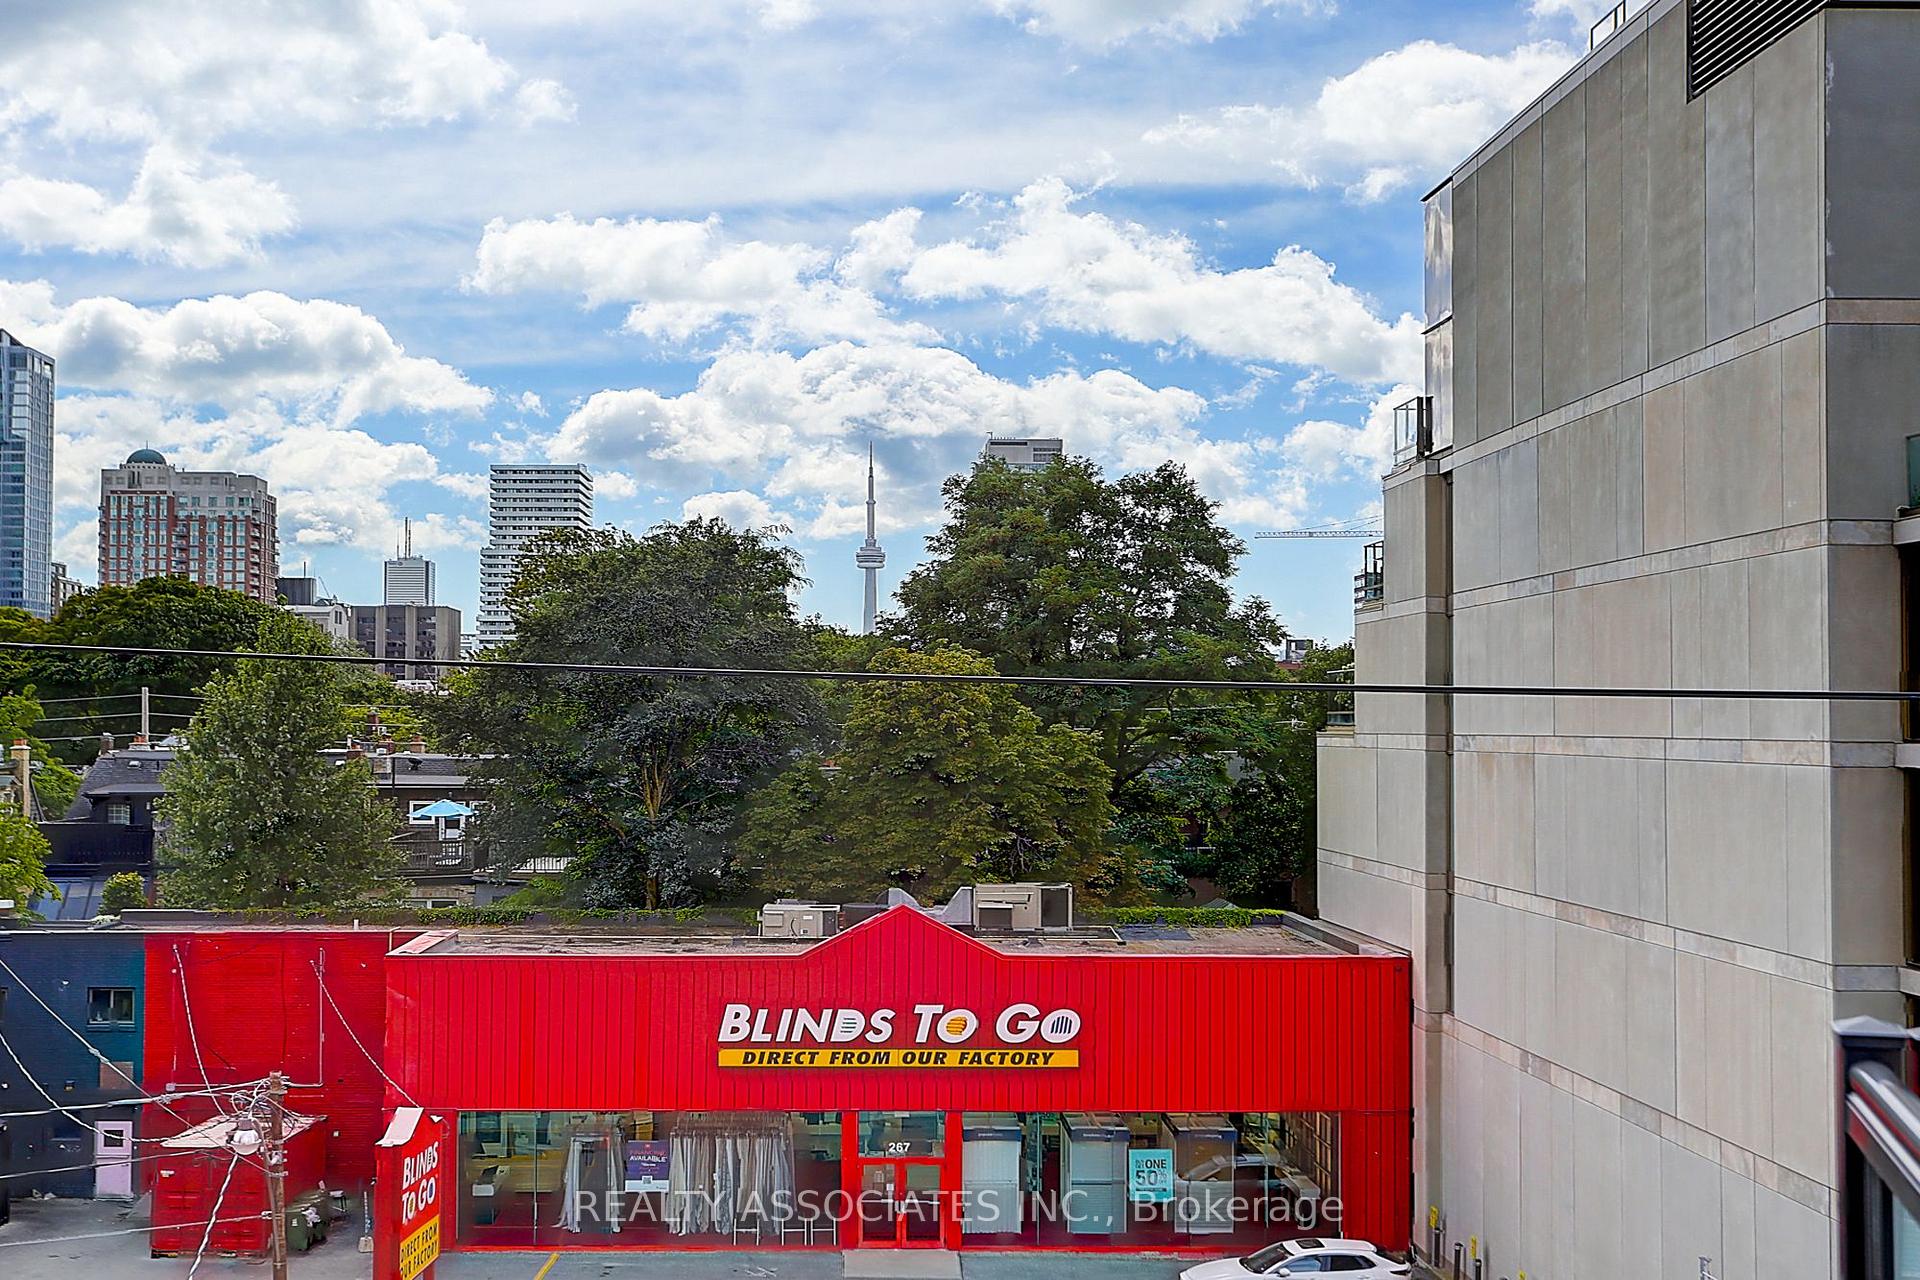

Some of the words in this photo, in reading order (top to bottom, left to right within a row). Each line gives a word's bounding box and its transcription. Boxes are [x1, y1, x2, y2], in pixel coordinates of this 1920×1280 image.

[717, 1003, 896, 1043] BLINDS
[914, 1004, 978, 1043] TO
[995, 1003, 1081, 1043] GO
[742, 1051, 819, 1065] DIRECT
[830, 1051, 890, 1065] FROM
[901, 1051, 947, 1065] OUR
[958, 1051, 1054, 1065] FACTORY
[888, 1142, 911, 1153] 267
[1145, 1159, 1167, 1169] ONE
[402, 1141, 439, 1190] BLINDS
[402, 1191, 416, 1224] TO
[418, 1178, 437, 1211] GO
[401, 1235, 420, 1263] DIRECT
[422, 1223, 438, 1246] FROM
[413, 1240, 438, 1271] FACTORY
